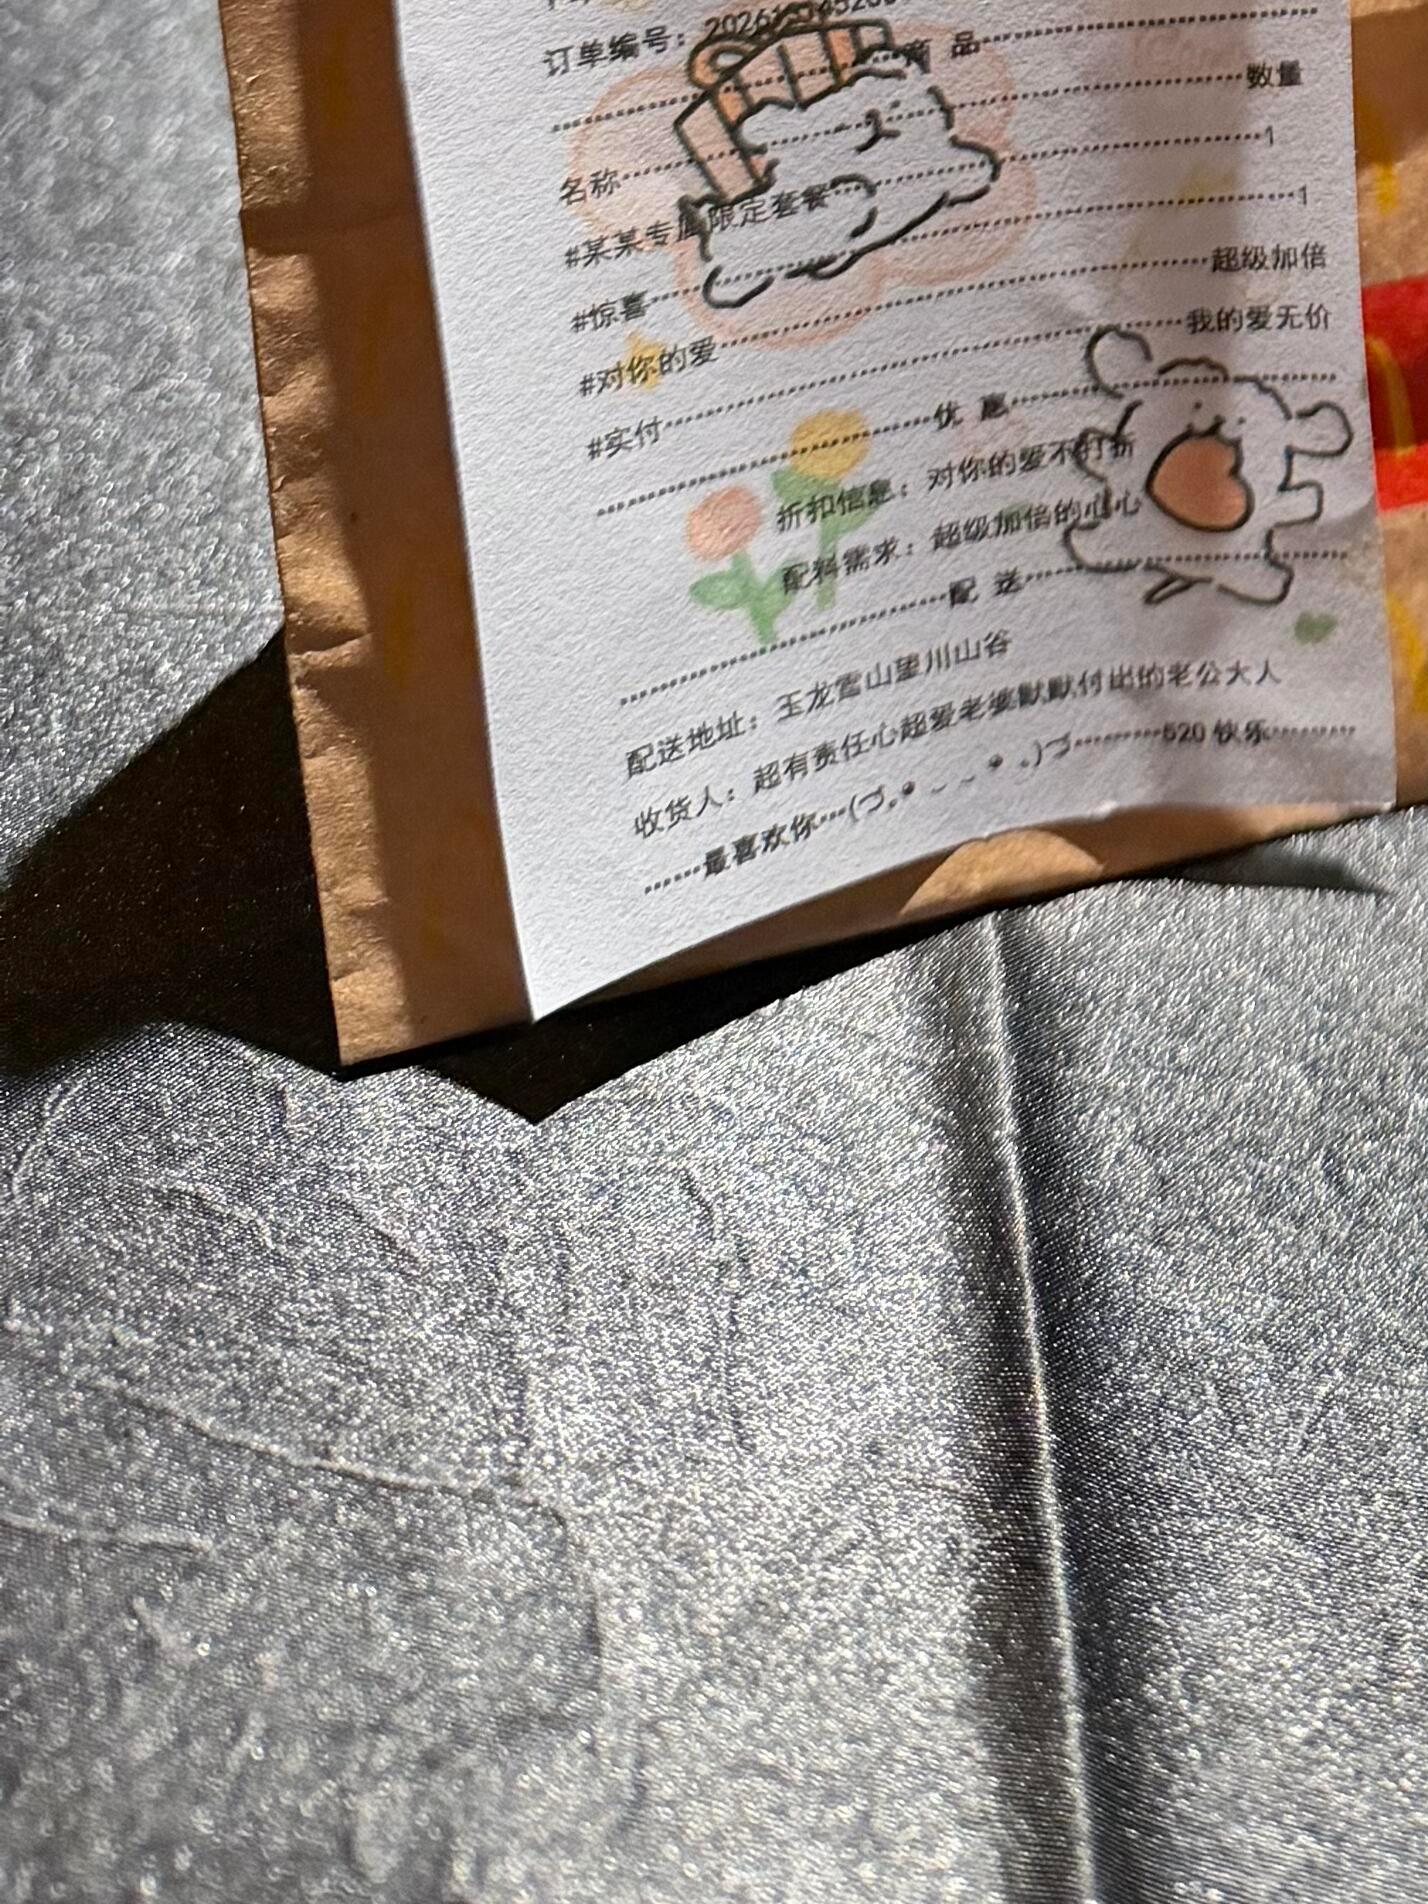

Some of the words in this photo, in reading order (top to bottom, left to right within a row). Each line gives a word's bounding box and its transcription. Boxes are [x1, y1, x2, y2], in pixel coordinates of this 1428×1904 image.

[559, 168, 621, 206] 名称
[1247, 60, 1302, 89] 数量
[579, 335, 718, 397] #对你的爱
[1212, 241, 1328, 273] 超级加倍
[587, 416, 663, 459] #实付
[1186, 302, 1331, 335] 我的爱无价
